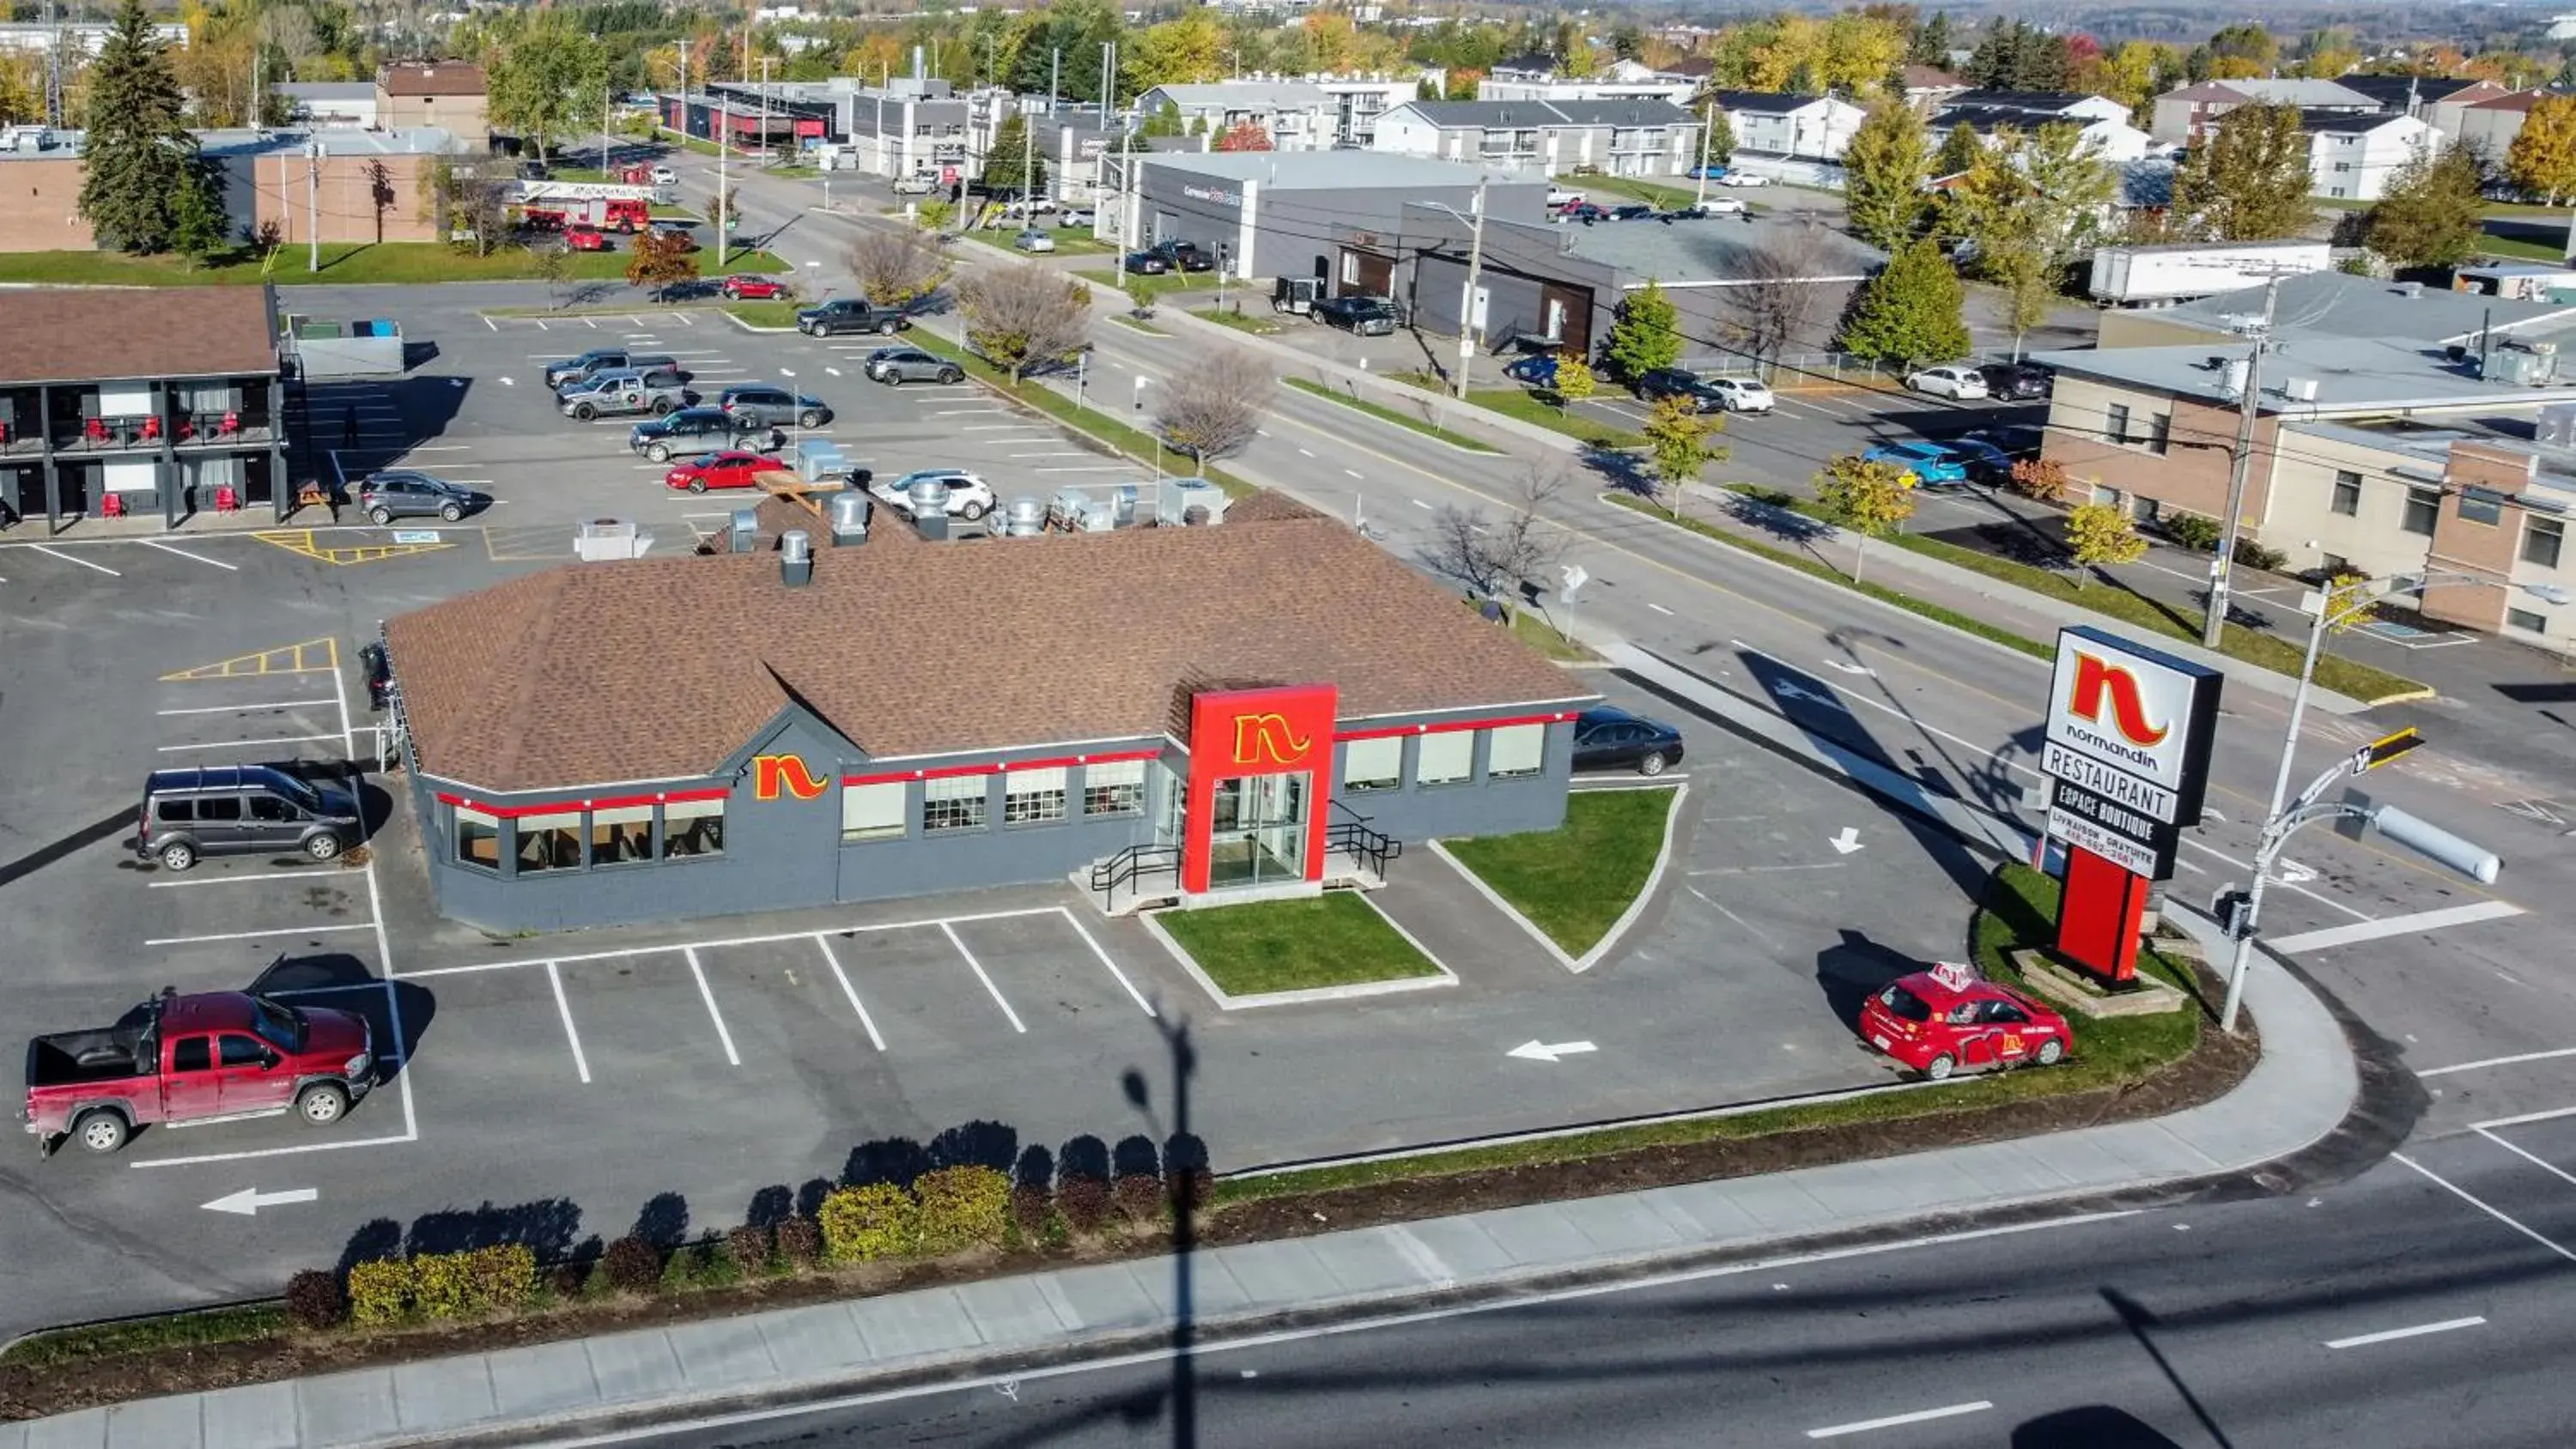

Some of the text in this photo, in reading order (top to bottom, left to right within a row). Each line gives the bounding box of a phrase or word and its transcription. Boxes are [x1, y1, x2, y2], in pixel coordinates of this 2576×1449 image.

[2067, 724, 2159, 771] normandin
[2050, 749, 2166, 815] RESTAURANT
[2052, 811, 2153, 864] LIVRAISON GRATUITE
[2059, 785, 2154, 840] ESPACE BOUTIQUE
